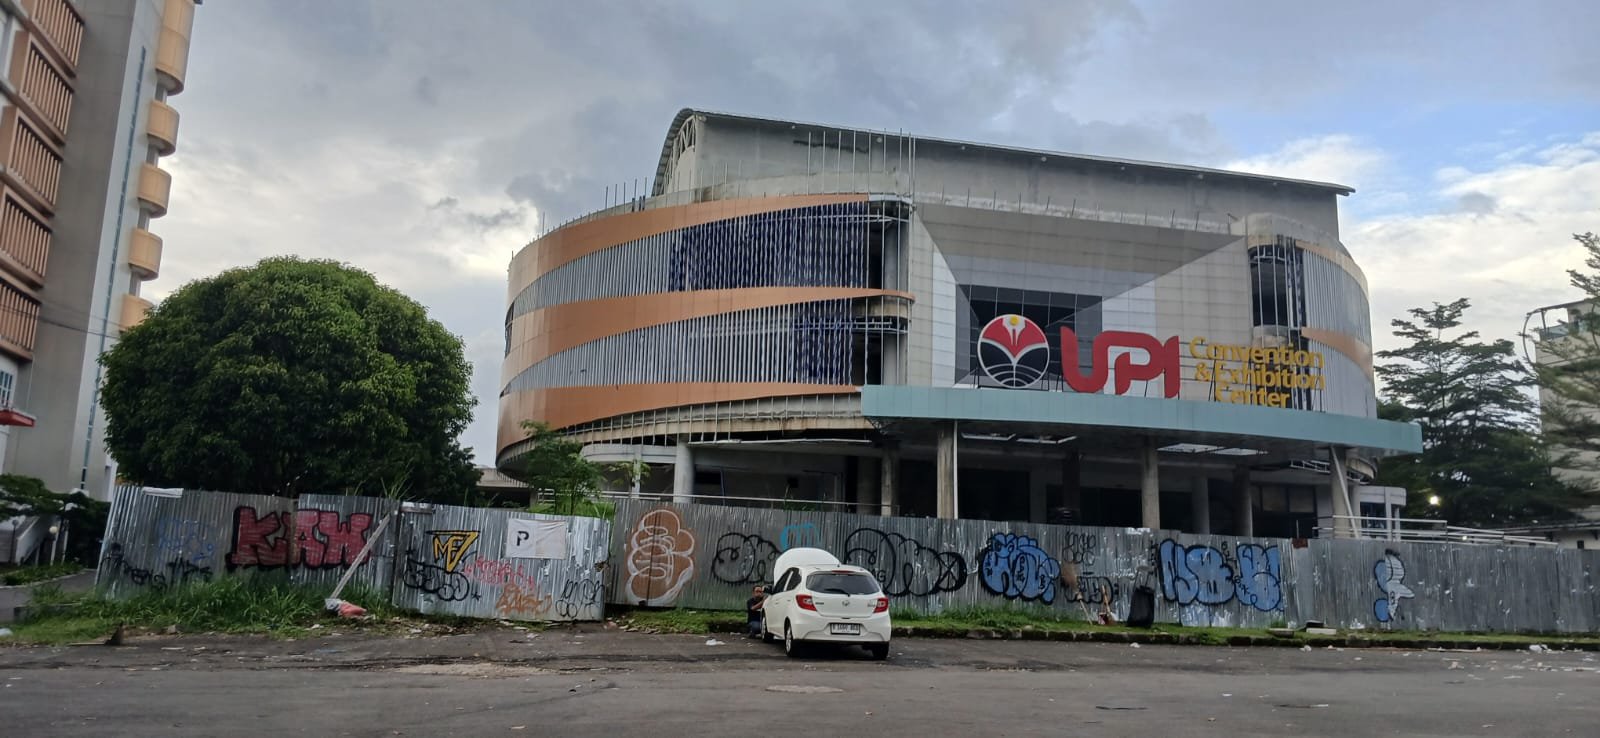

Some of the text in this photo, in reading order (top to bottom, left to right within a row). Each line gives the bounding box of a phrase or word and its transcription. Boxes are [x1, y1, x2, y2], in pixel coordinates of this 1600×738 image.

[1060, 326, 1180, 399] UPI
[1189, 336, 1325, 369] Convention
[1195, 360, 1326, 390] & Exhibition
[1214, 383, 1291, 409] Center
